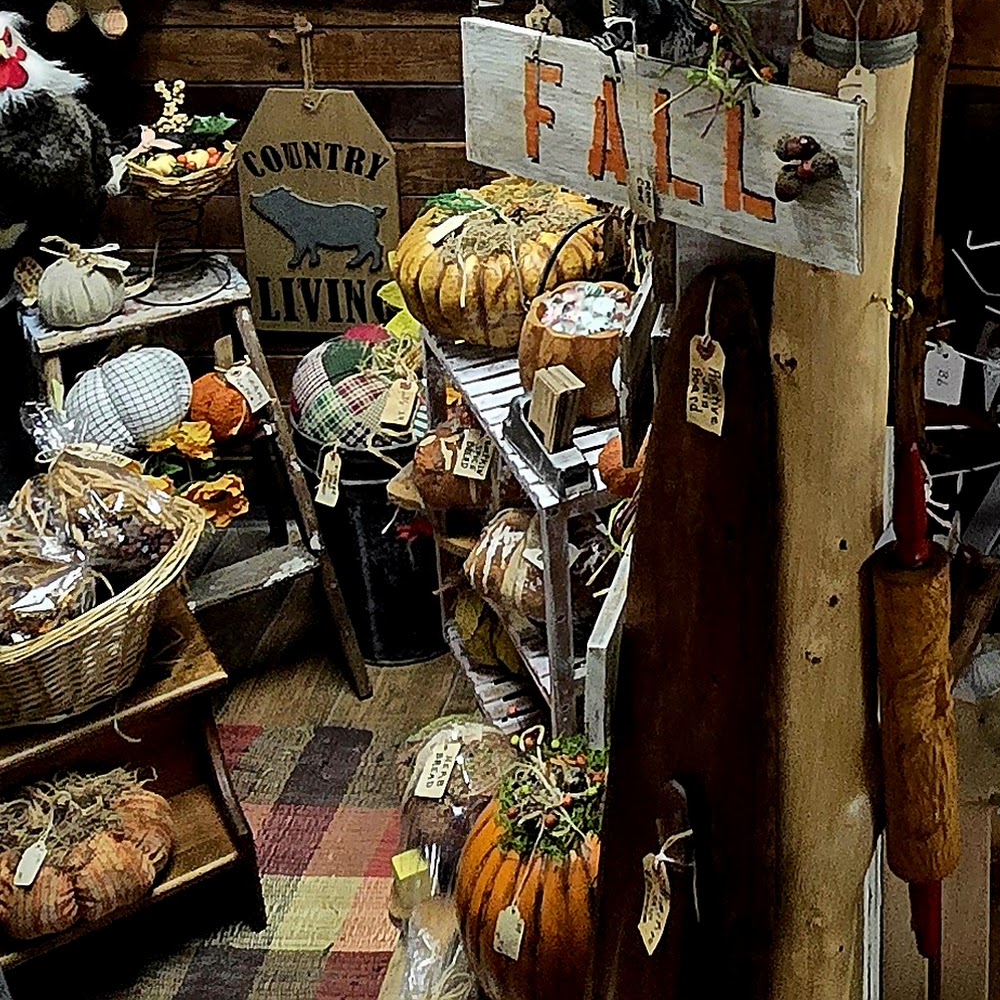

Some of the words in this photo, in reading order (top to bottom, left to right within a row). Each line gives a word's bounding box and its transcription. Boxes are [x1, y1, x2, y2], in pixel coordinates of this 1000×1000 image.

[523, 55, 777, 223] FALL
[241, 141, 390, 182] COUNTRY
[255, 275, 396, 325] LIVING
[426, 752, 444, 789] BREAD
[436, 755, 453, 787] HERB
